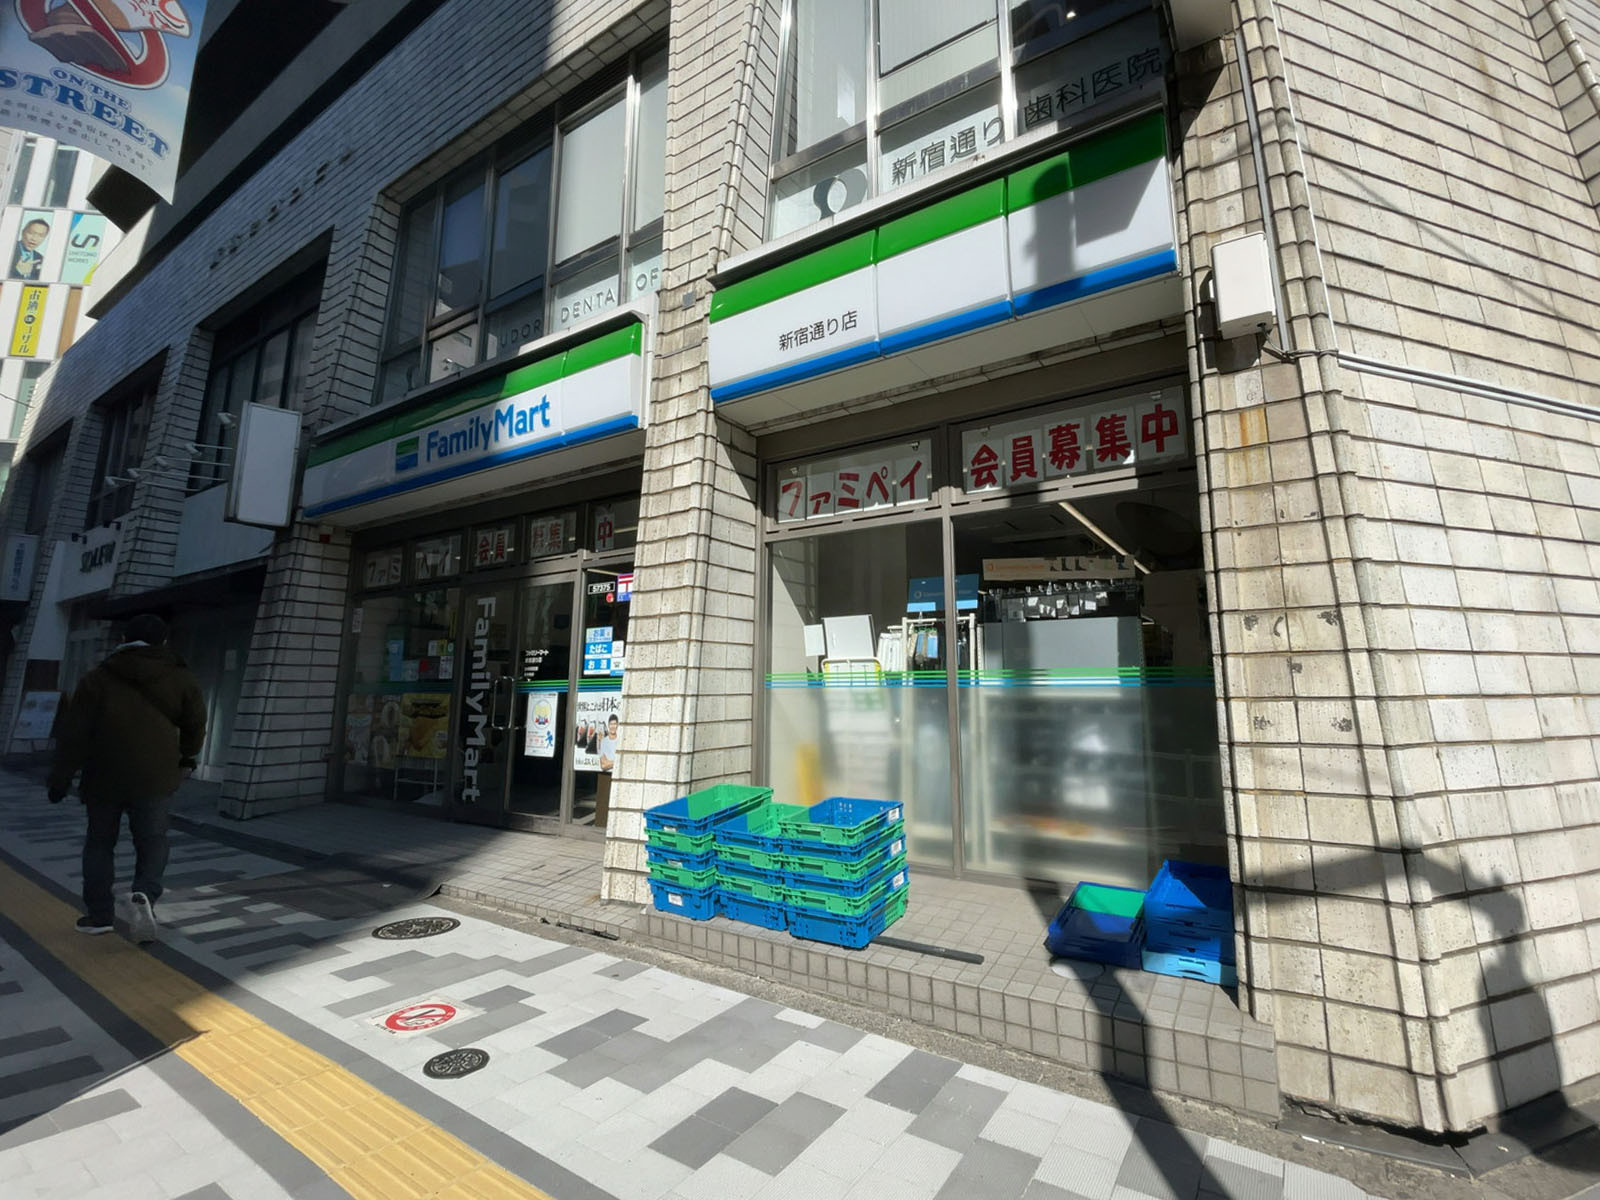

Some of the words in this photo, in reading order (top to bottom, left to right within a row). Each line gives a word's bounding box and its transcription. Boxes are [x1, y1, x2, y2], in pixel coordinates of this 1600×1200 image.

[0, 69, 168, 157] STREET
[53, 69, 85, 86] ON
[90, 83, 129, 110] THE
[891, 117, 1005, 186] 新宿通り
[1024, 47, 1163, 130] 歯科医院
[778, 310, 858, 352] 新宿通り店
[426, 394, 550, 463] FamilyMart
[781, 459, 923, 518] ファミペイ
[969, 403, 1179, 488] 会員募集中
[597, 519, 614, 548] 中
[588, 643, 608, 654] たばこ
[461, 596, 496, 803] FamilyMart
